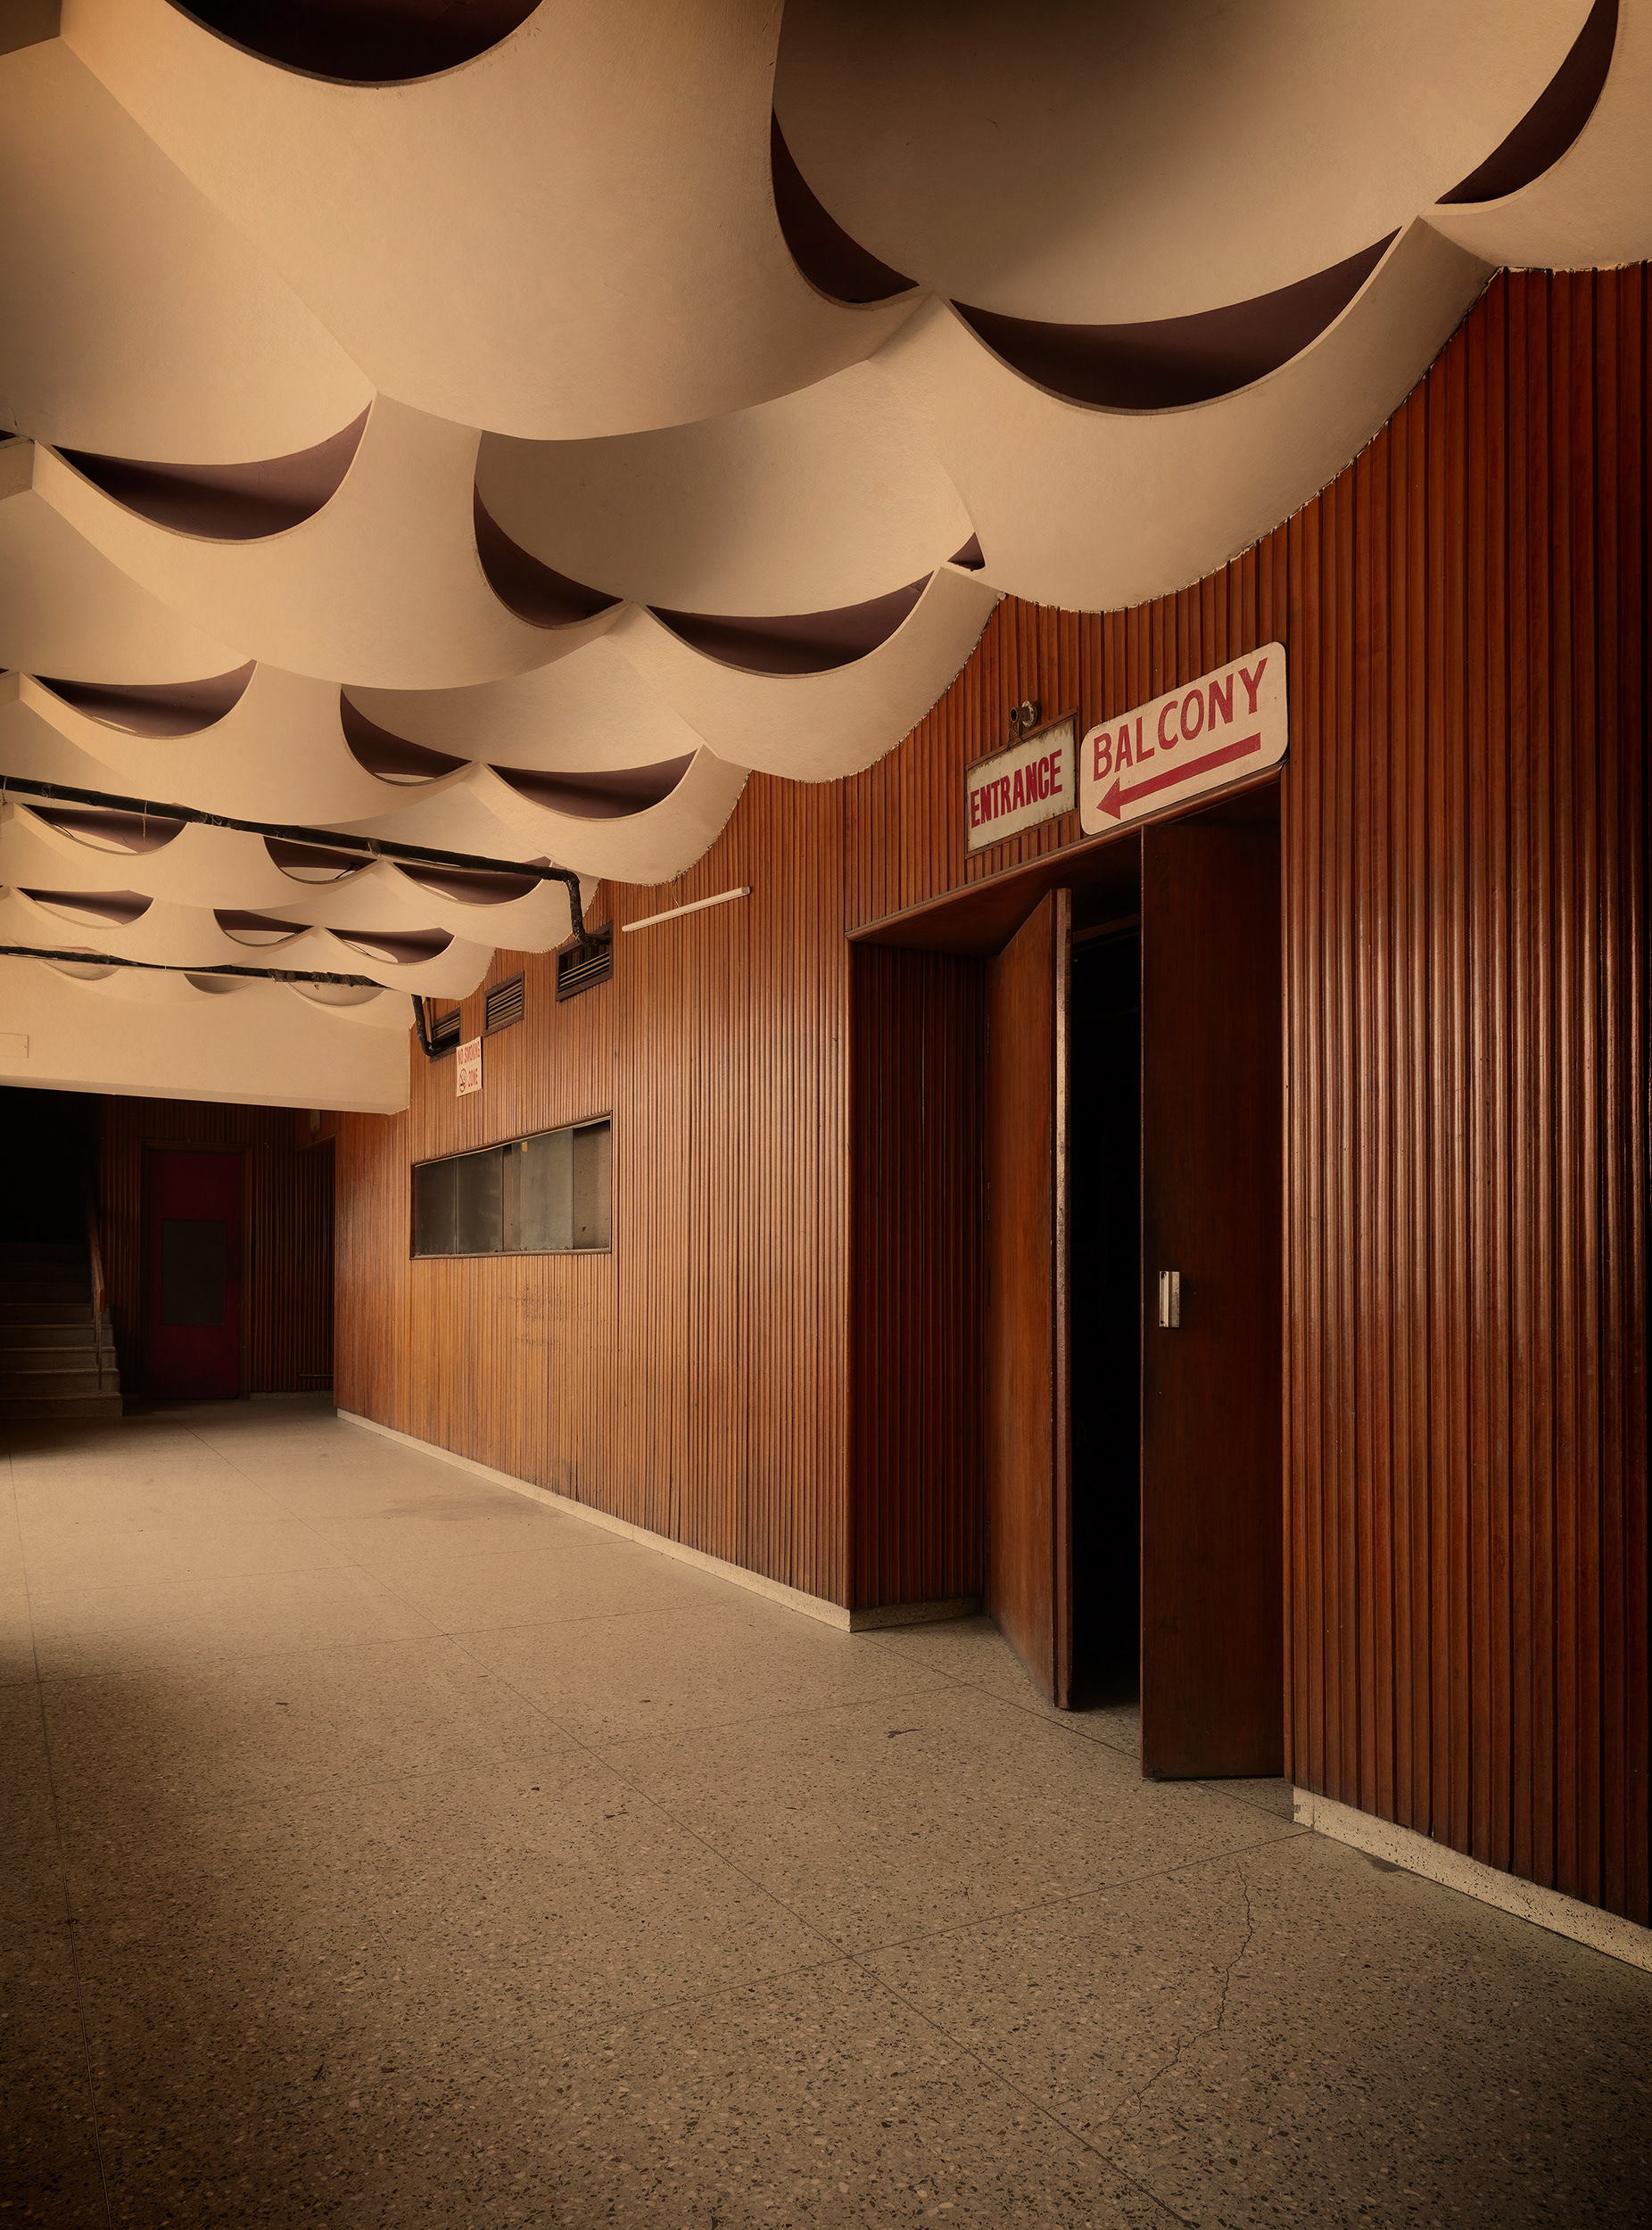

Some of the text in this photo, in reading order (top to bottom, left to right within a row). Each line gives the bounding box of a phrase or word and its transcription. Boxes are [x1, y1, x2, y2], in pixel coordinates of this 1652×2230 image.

[1093, 657, 1268, 781] BALCONY
[971, 748, 1062, 829] ENTRANCE
[458, 1040, 480, 1066] NO SMOKING
[468, 1068, 478, 1087] ZONE
